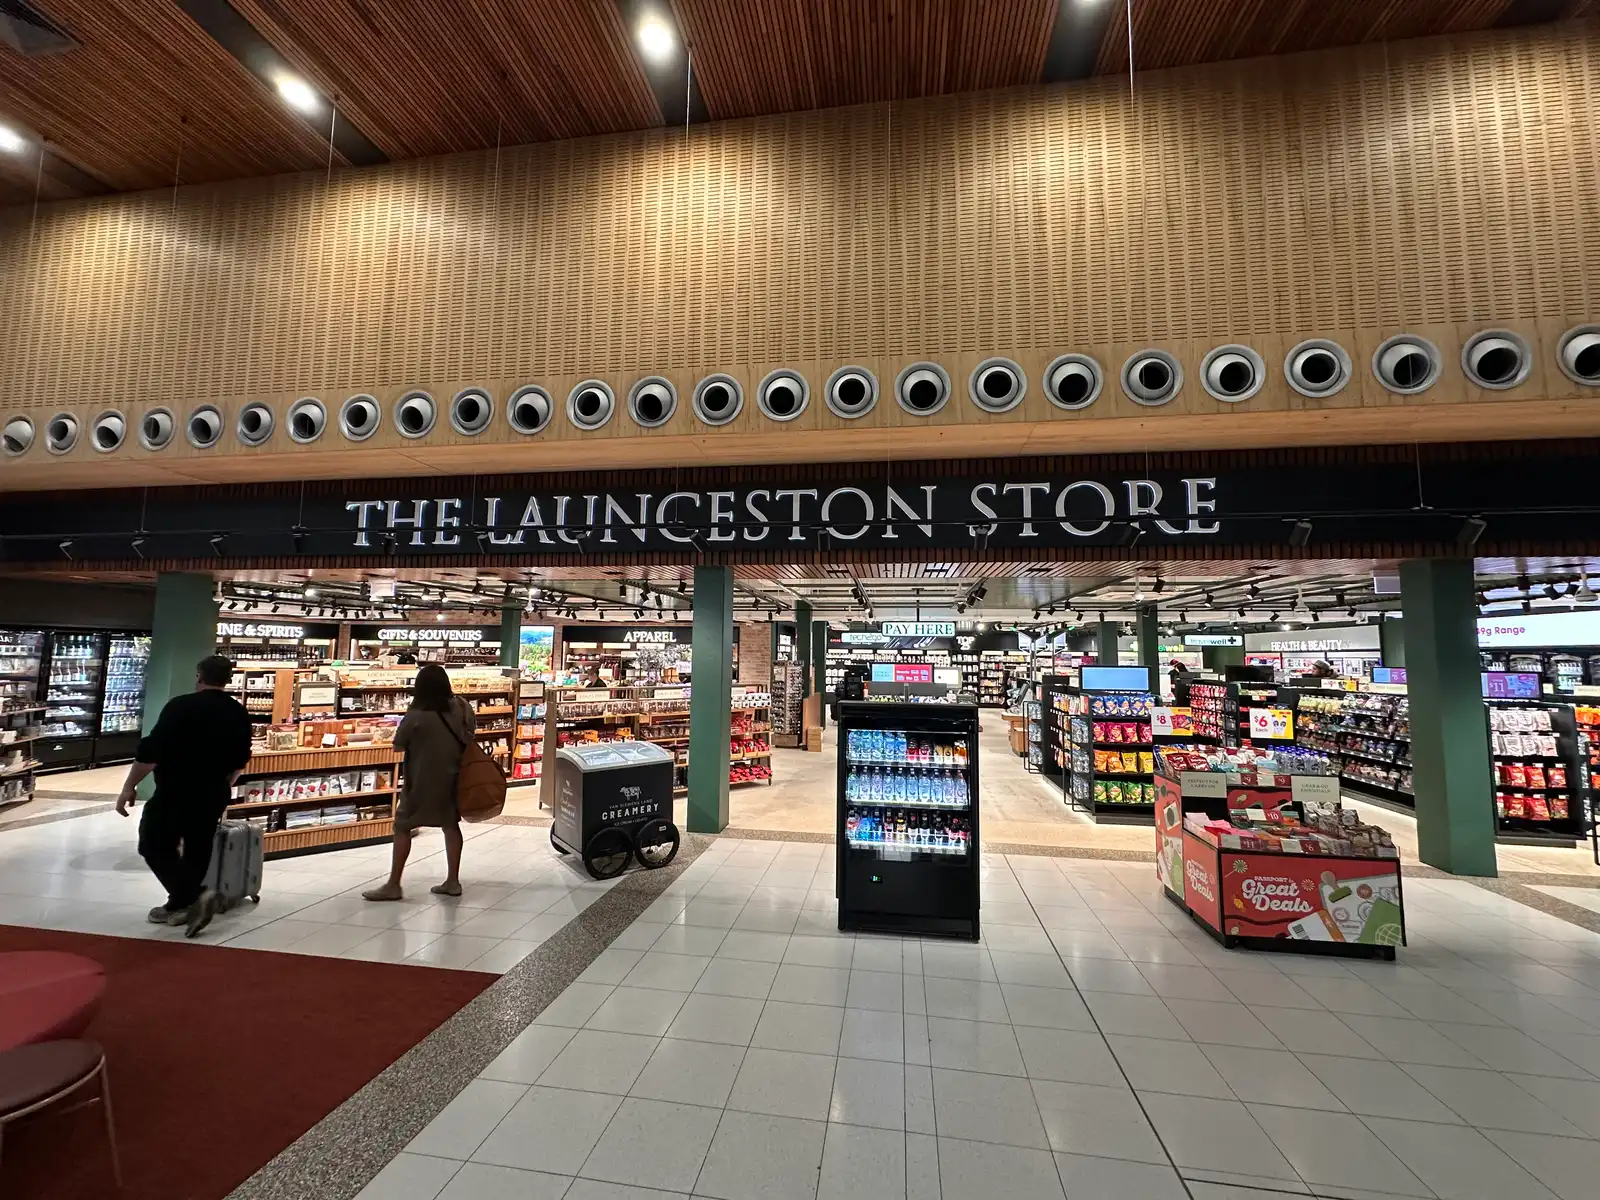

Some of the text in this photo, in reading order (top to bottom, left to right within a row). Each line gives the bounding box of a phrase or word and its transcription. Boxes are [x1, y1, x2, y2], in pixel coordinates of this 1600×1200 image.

[345, 477, 1220, 546] THE LAUNCESTON STORE
[216, 622, 304, 638] INE & SPIRITS
[377, 628, 408, 641] GIFTS
[418, 629, 483, 642] SOUVENIRS
[884, 623, 953, 635] PAY HERE
[1494, 626, 1526, 636] Range
[623, 631, 677, 643] APPAREL
[955, 635, 975, 645] TOP
[1270, 641, 1300, 651] HEALTH
[1307, 639, 1343, 651] BEAUTY
[1156, 714, 1167, 724] $8
[1254, 715, 1268, 727] $6
[601, 803, 659, 821] CREAMERY
[1267, 811, 1279, 820] $10
[1186, 859, 1209, 885] Great
[1190, 874, 1215, 902] Deals
[1241, 879, 1300, 900] Great
[1251, 894, 1314, 913] Deals
